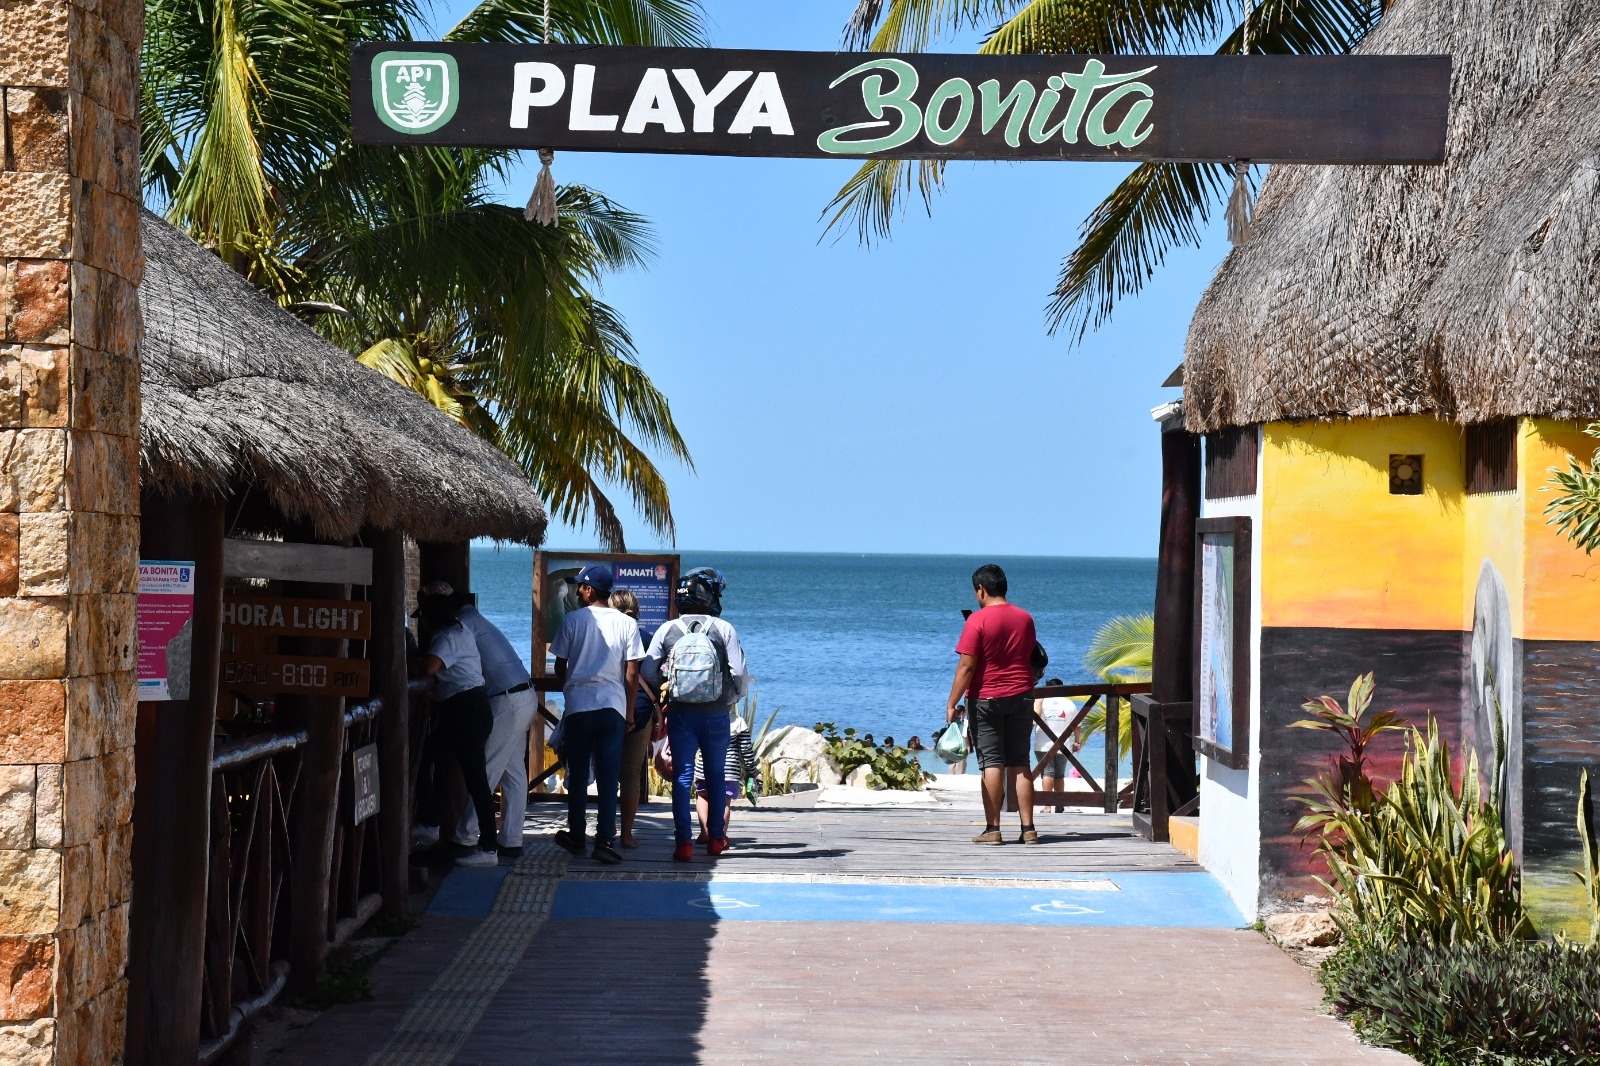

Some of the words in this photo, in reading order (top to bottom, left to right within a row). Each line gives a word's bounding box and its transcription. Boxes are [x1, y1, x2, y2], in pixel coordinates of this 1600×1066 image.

[395, 65, 432, 84] API
[509, 61, 795, 137] PLAYA
[816, 57, 1158, 155] Bonita
[150, 567, 178, 575] BONITA
[619, 567, 654, 577] MANATÍ
[222, 602, 286, 628] HORA
[293, 605, 364, 632] LIGHT
